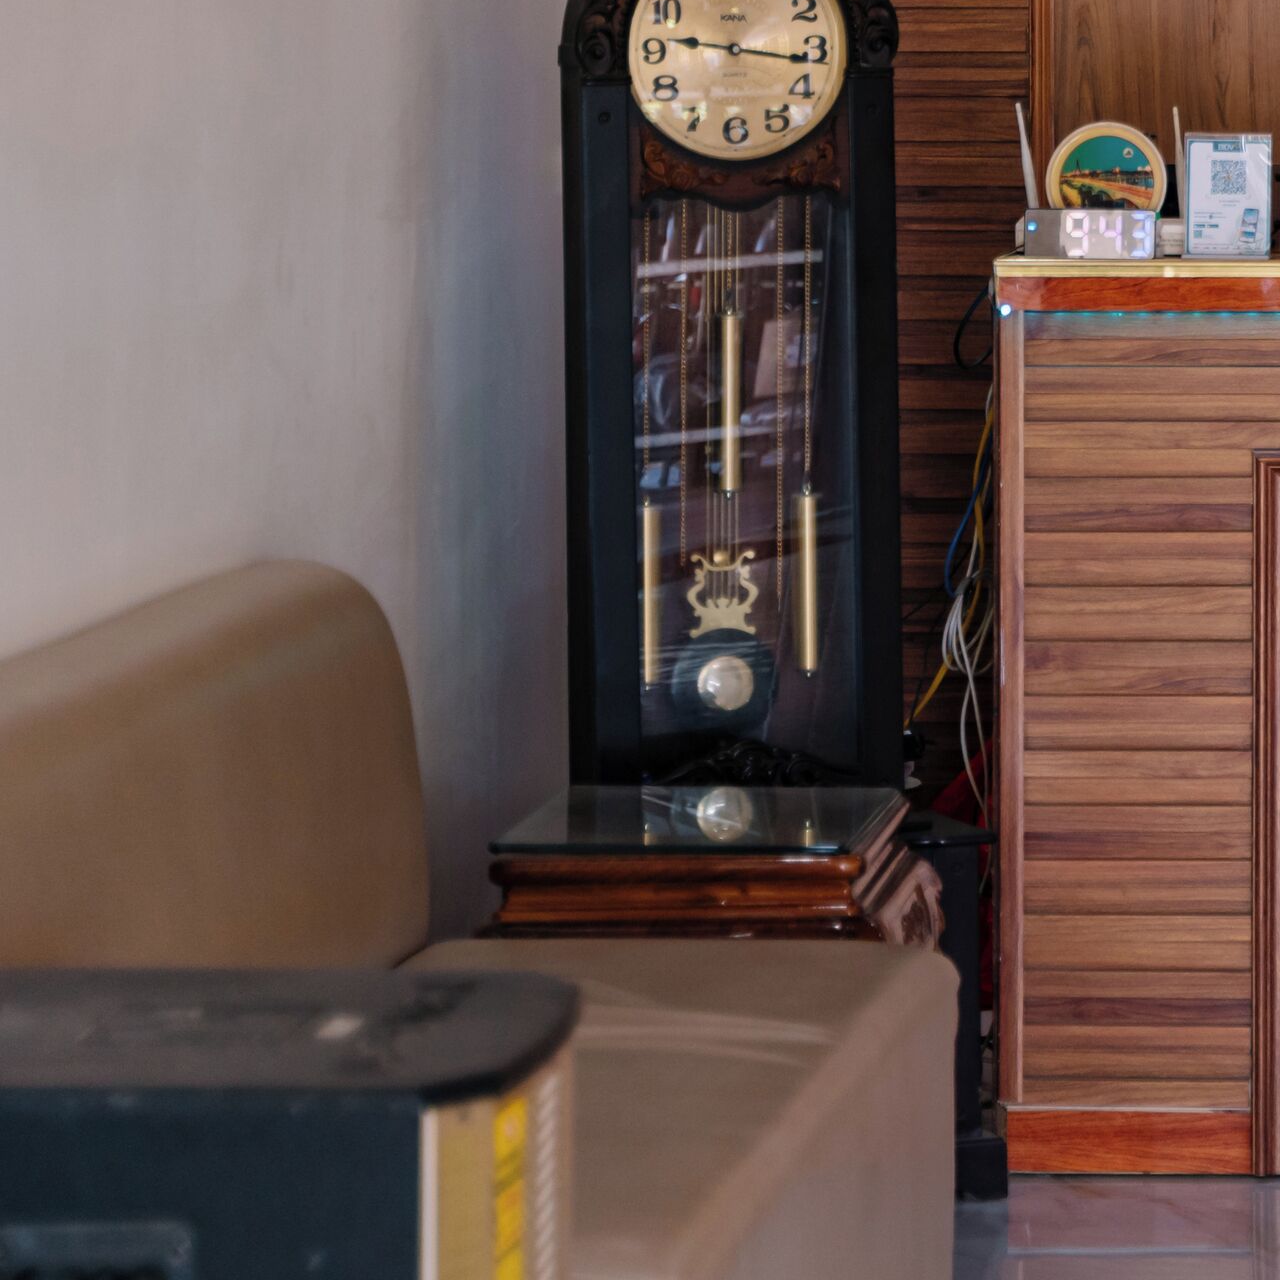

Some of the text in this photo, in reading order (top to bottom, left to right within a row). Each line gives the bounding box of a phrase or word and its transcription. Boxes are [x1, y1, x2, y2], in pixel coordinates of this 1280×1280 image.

[642, 38, 666, 64] 9
[803, 35, 828, 64] 3
[653, 75, 679, 102] 8
[788, 73, 815, 99] 4
[722, 116, 748, 144] 6
[764, 103, 789, 133] 5
